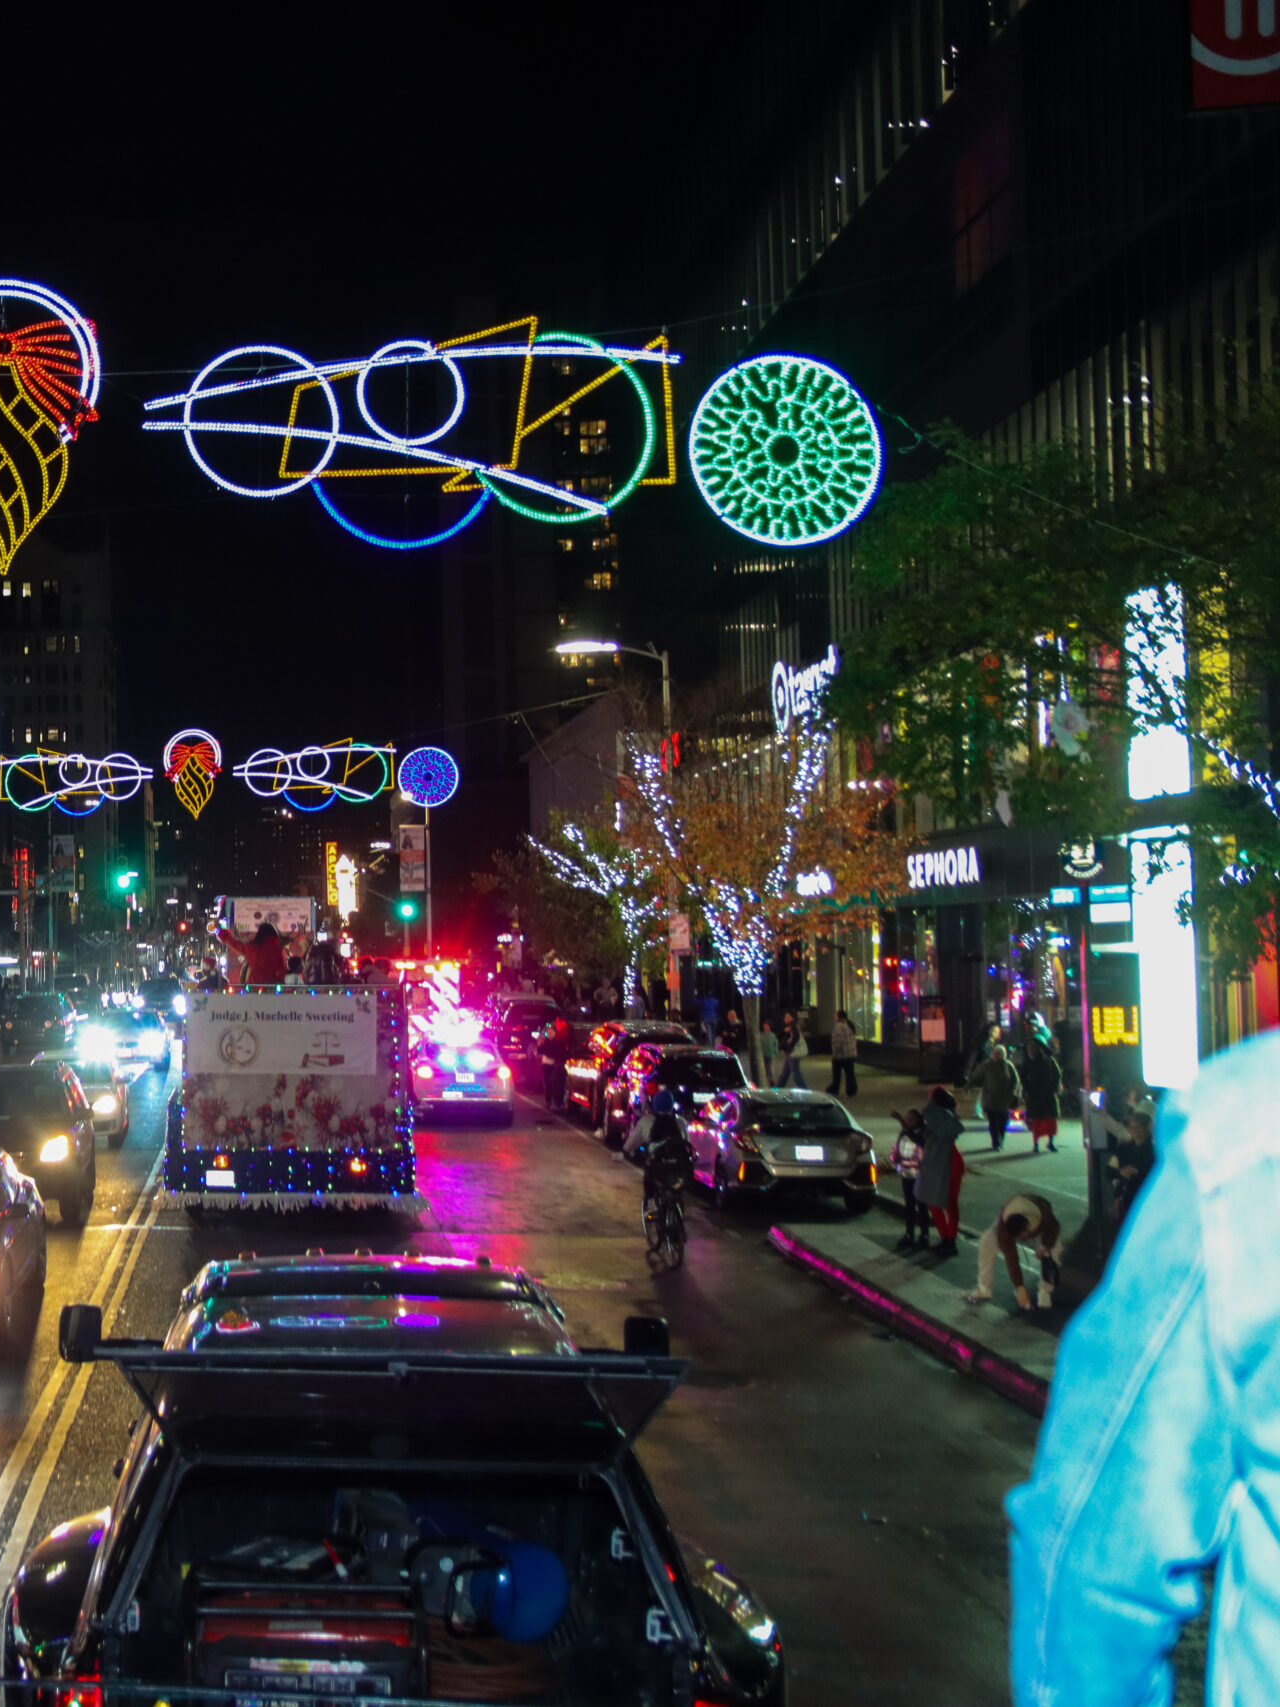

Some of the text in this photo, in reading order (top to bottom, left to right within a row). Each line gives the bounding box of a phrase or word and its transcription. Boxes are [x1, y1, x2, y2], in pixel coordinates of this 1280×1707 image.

[907, 846, 980, 889] SEPHORA
[210, 1010, 355, 1024] Judge J. Machelle Sweeting
